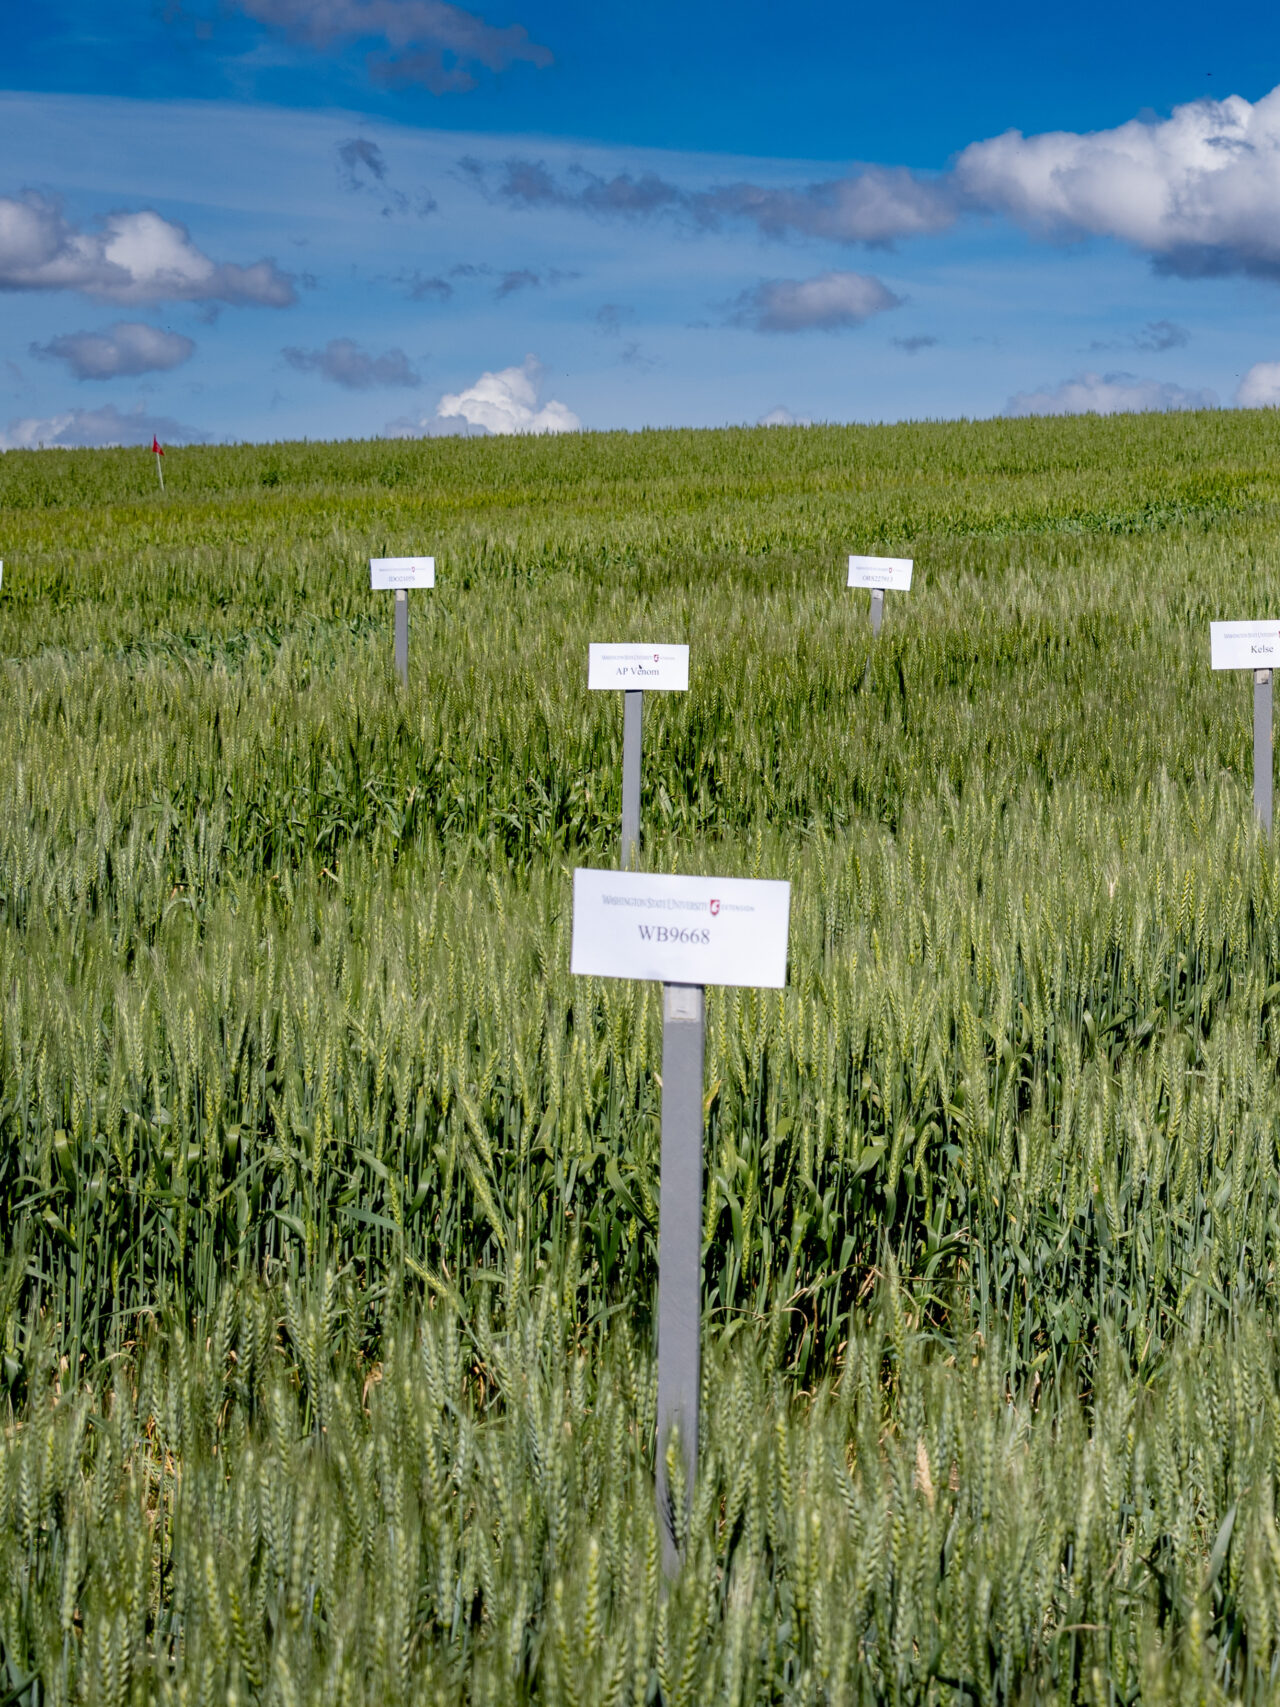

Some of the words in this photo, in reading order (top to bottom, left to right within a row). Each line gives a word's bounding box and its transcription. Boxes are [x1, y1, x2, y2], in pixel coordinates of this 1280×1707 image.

[1250, 645, 1274, 654] Kelse
[616, 667, 629, 676] AP
[630, 667, 660, 676] Venom
[638, 924, 711, 945] WB9668
